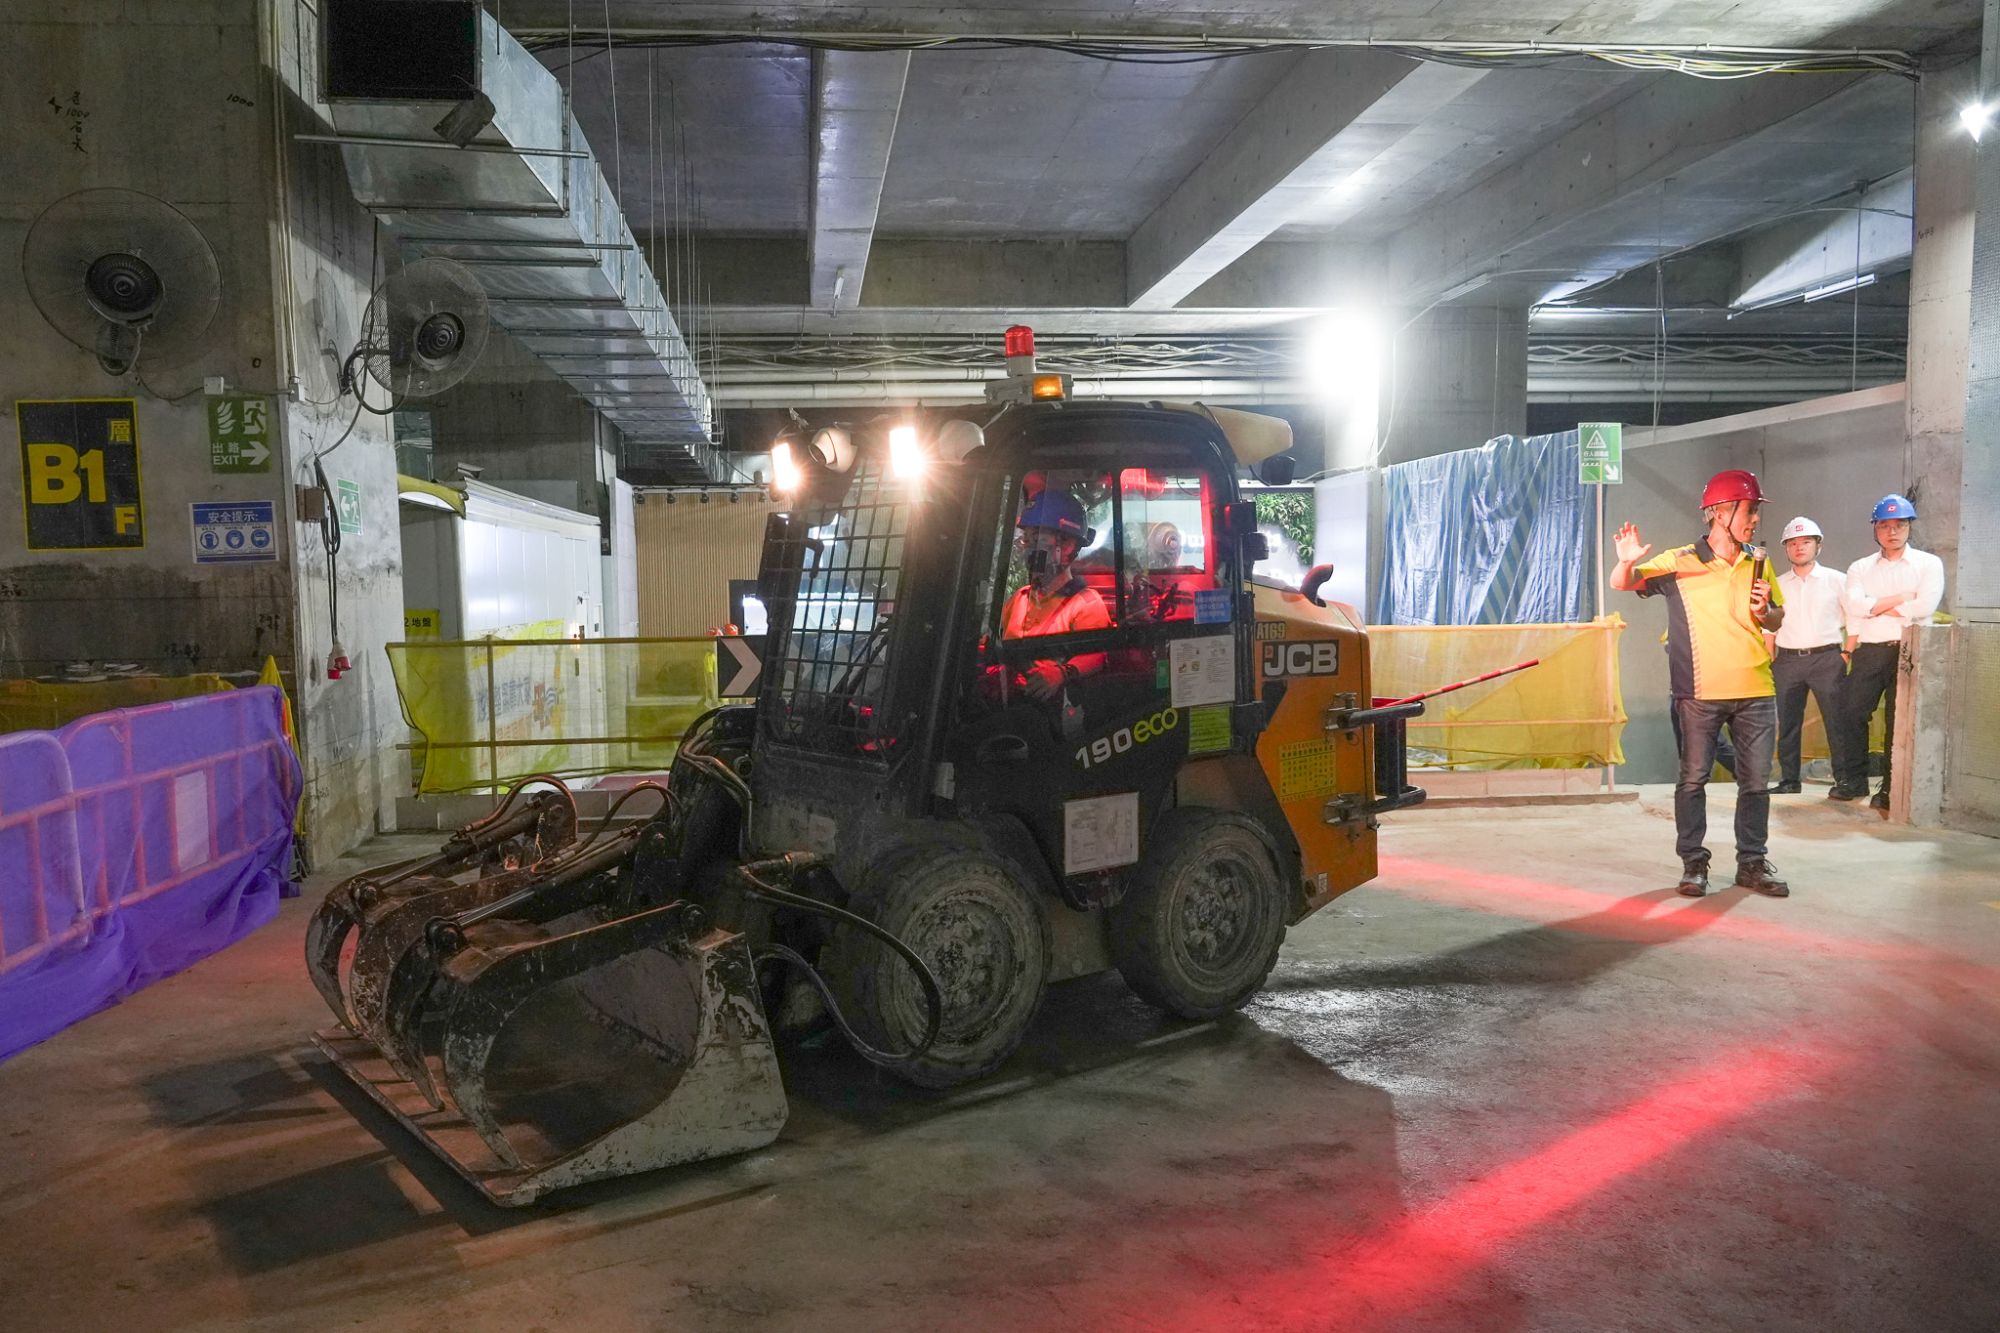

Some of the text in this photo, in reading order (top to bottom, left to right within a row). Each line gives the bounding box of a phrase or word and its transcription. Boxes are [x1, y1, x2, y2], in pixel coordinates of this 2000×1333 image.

[27, 443, 107, 504] B1
[213, 455, 240, 465] EXIT
[114, 506, 136, 534] F
[1256, 623, 1286, 640] A169
[1264, 643, 1337, 676] JCB
